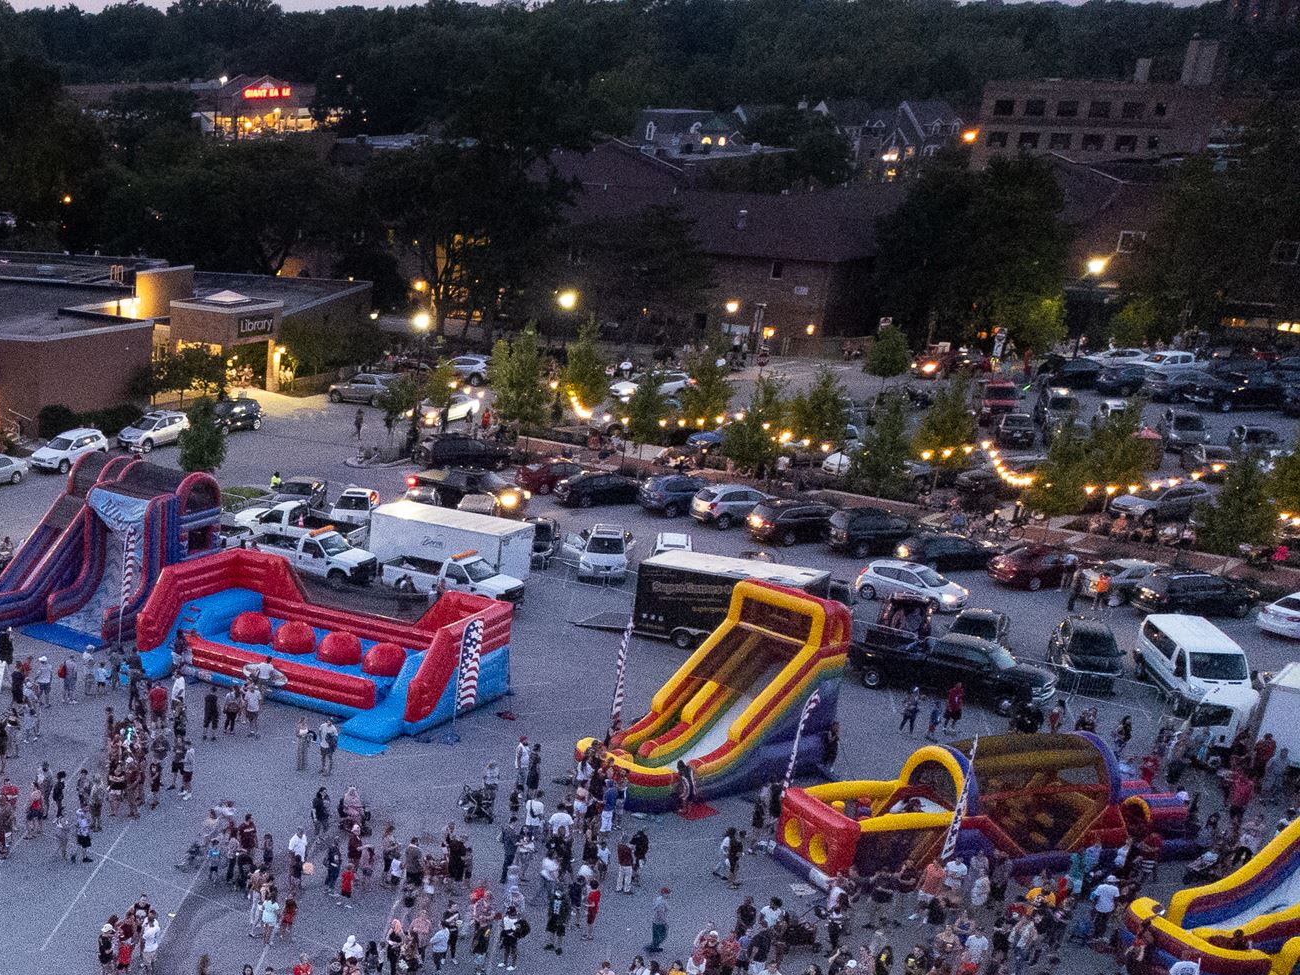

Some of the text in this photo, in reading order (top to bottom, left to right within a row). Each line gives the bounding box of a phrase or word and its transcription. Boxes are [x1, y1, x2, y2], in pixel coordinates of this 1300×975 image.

[244, 88, 291, 98] GIANT EALE
[240, 318, 273, 333] Library
